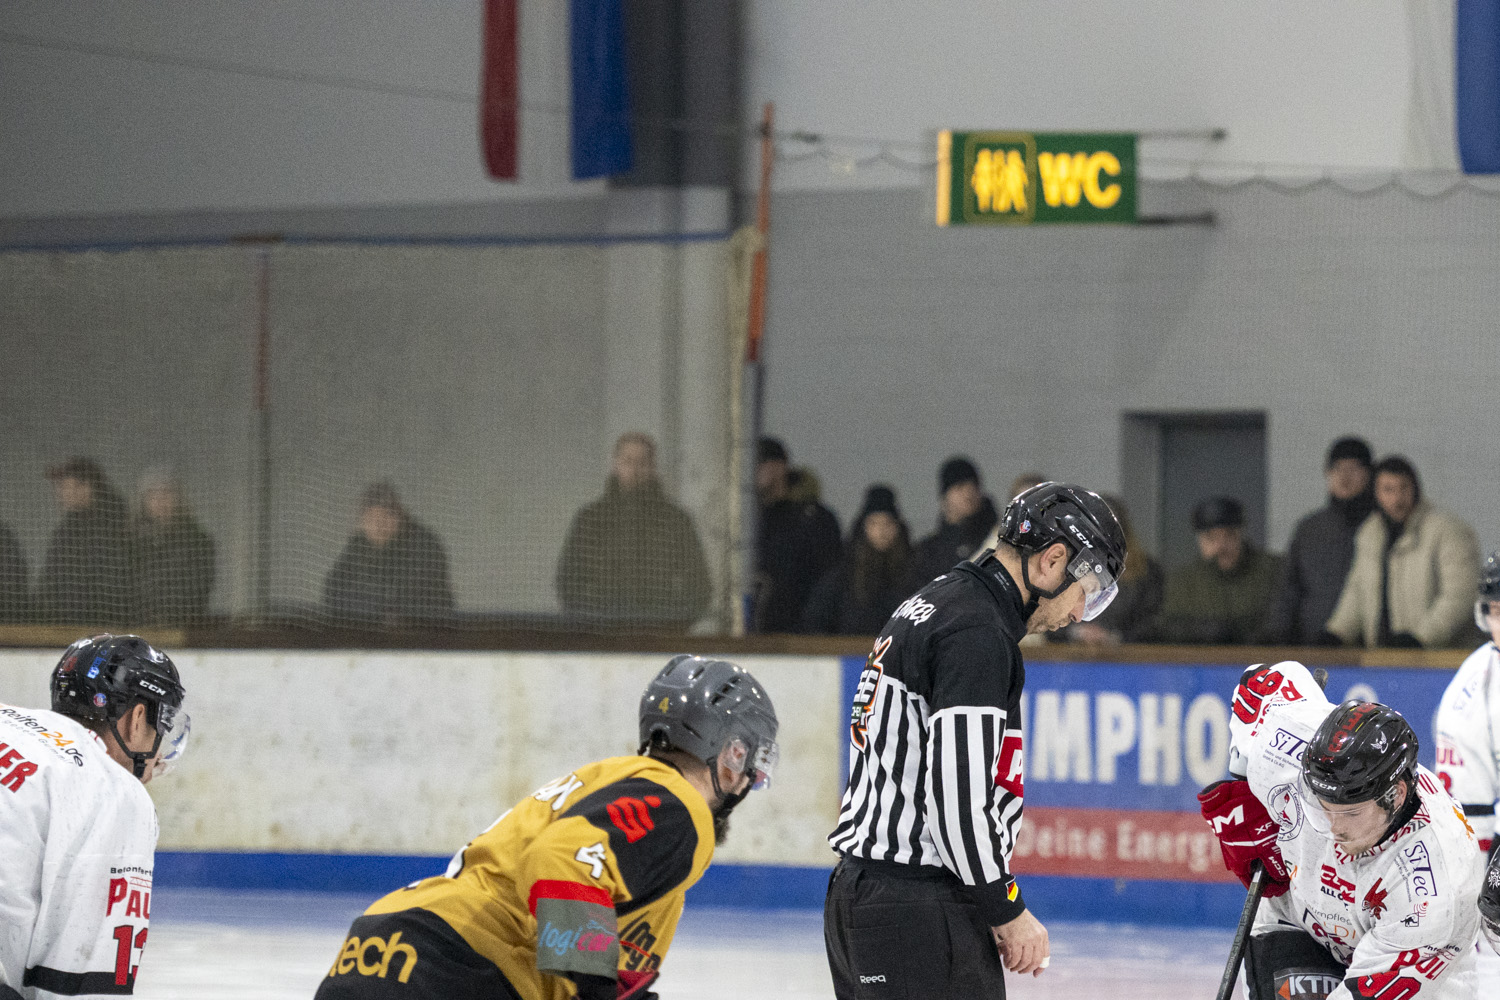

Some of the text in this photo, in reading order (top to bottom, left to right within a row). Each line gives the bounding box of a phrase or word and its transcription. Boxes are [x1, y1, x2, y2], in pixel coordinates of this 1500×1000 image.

[1038, 151, 1121, 208] WC
[1069, 524, 1093, 549] CCM
[139, 679, 167, 696] CCM
[657, 697, 669, 714] 4
[1312, 779, 1337, 791] CCM
[110, 866, 153, 877] Betonfert
[1404, 843, 1430, 897] SiTec
